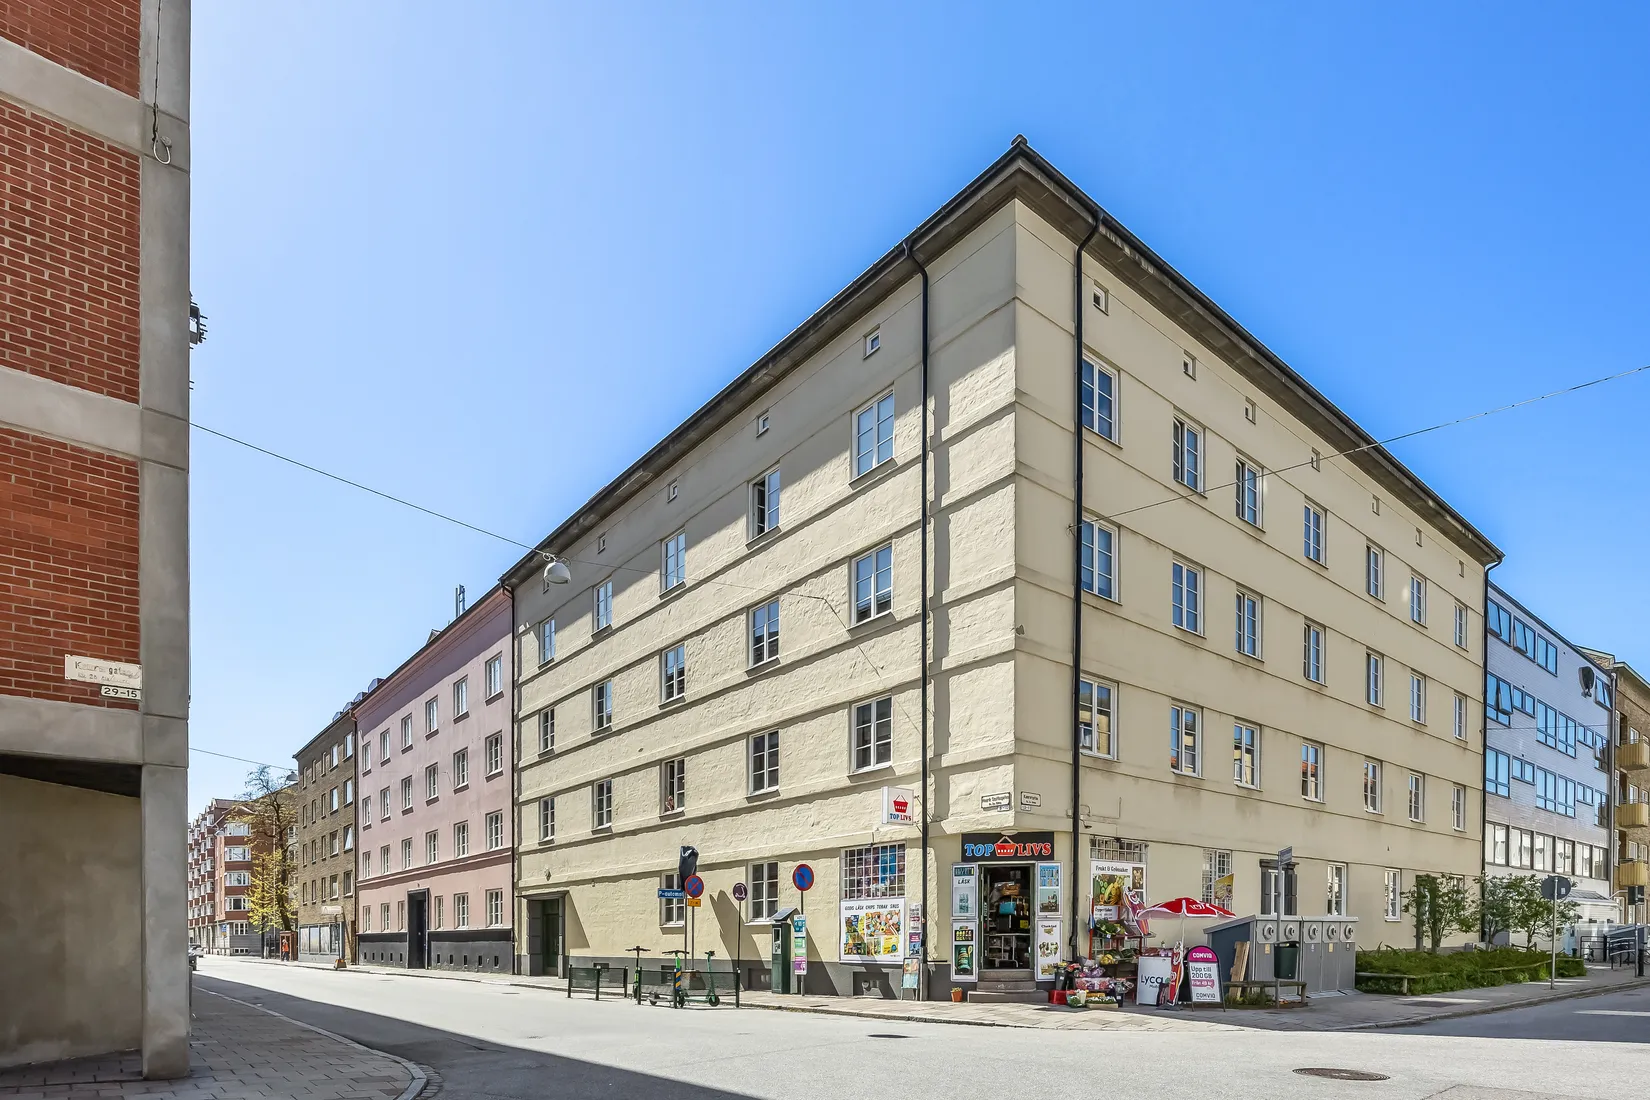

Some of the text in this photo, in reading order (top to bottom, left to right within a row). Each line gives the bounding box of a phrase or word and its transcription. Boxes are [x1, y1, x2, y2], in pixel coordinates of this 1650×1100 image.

[104, 687, 138, 698] 29-15
[900, 814, 912, 822] LIVS
[965, 842, 1051, 856] TOP LIVS
[1141, 974, 1163, 985] Lyca
